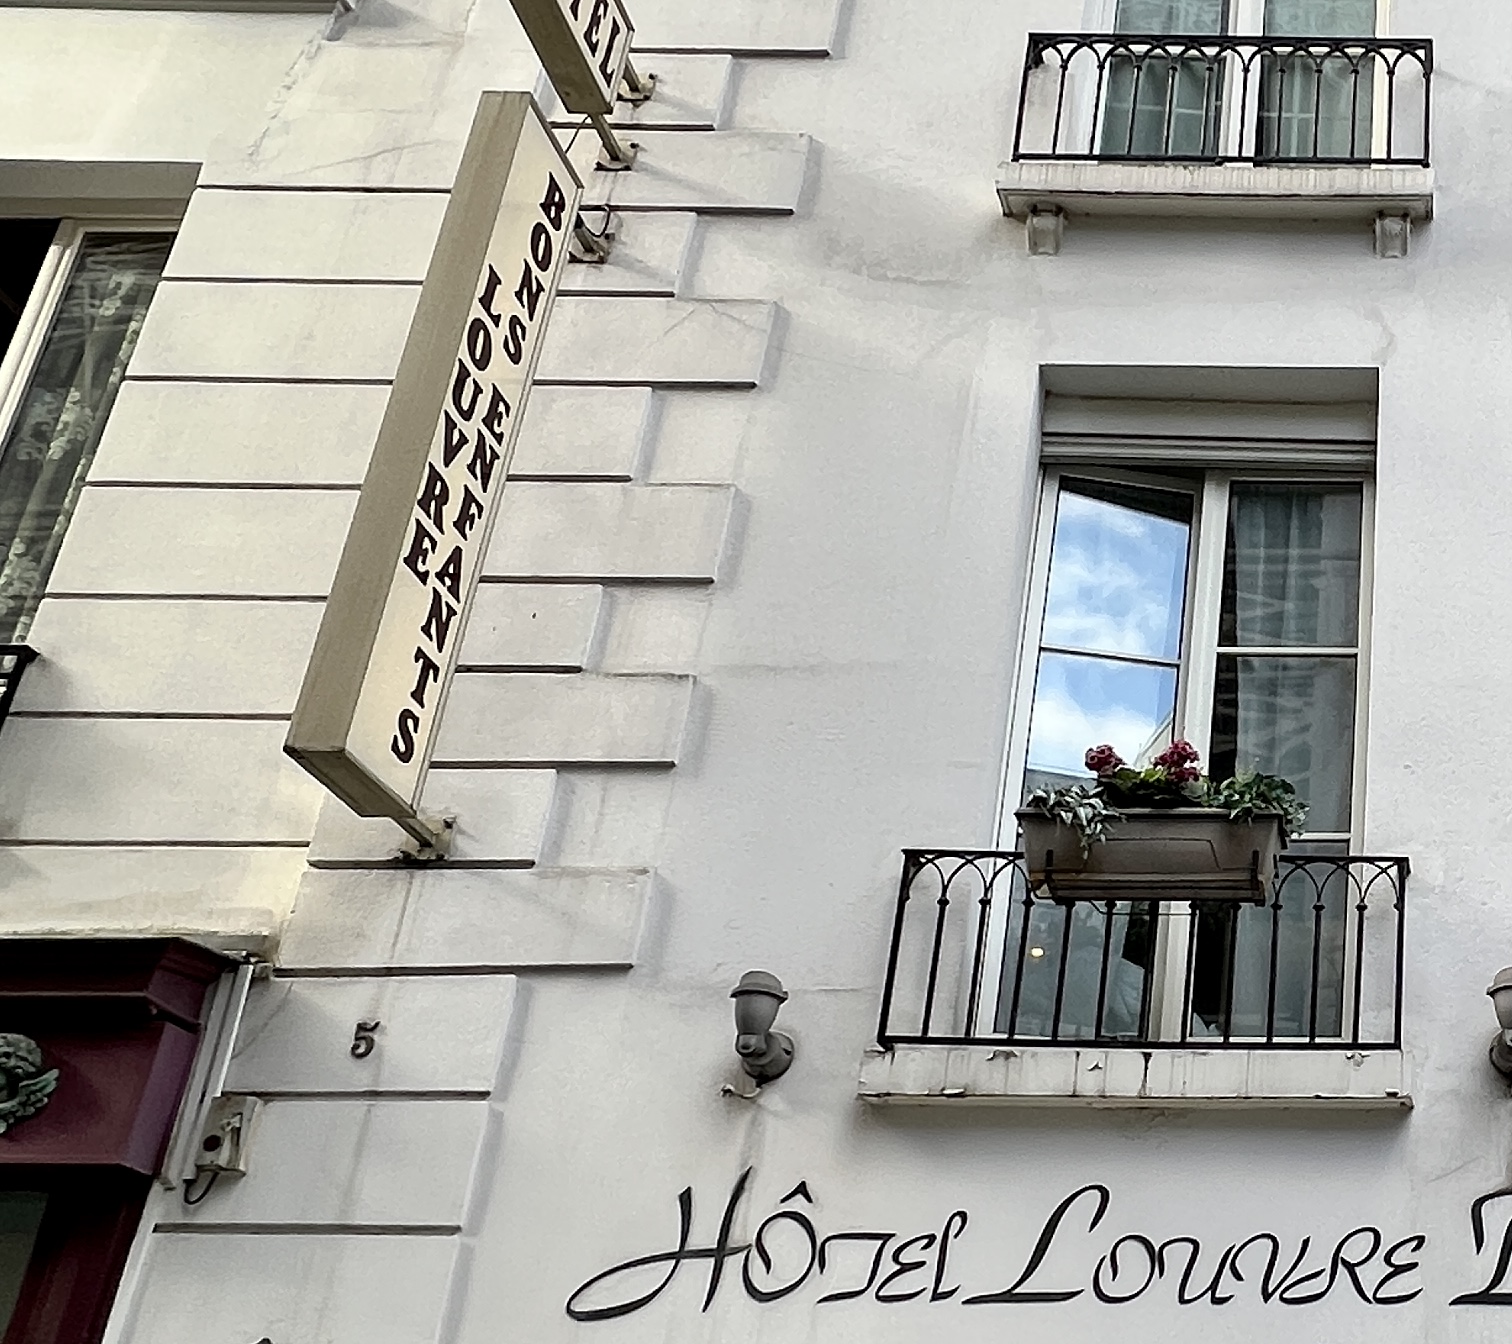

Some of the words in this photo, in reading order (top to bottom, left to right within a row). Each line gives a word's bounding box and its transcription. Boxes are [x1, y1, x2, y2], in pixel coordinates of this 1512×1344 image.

[502, 171, 566, 366] BONS
[403, 262, 502, 586] LOUVRE
[390, 382, 511, 764] ENFANTS
[350, 1021, 381, 1059] 5
